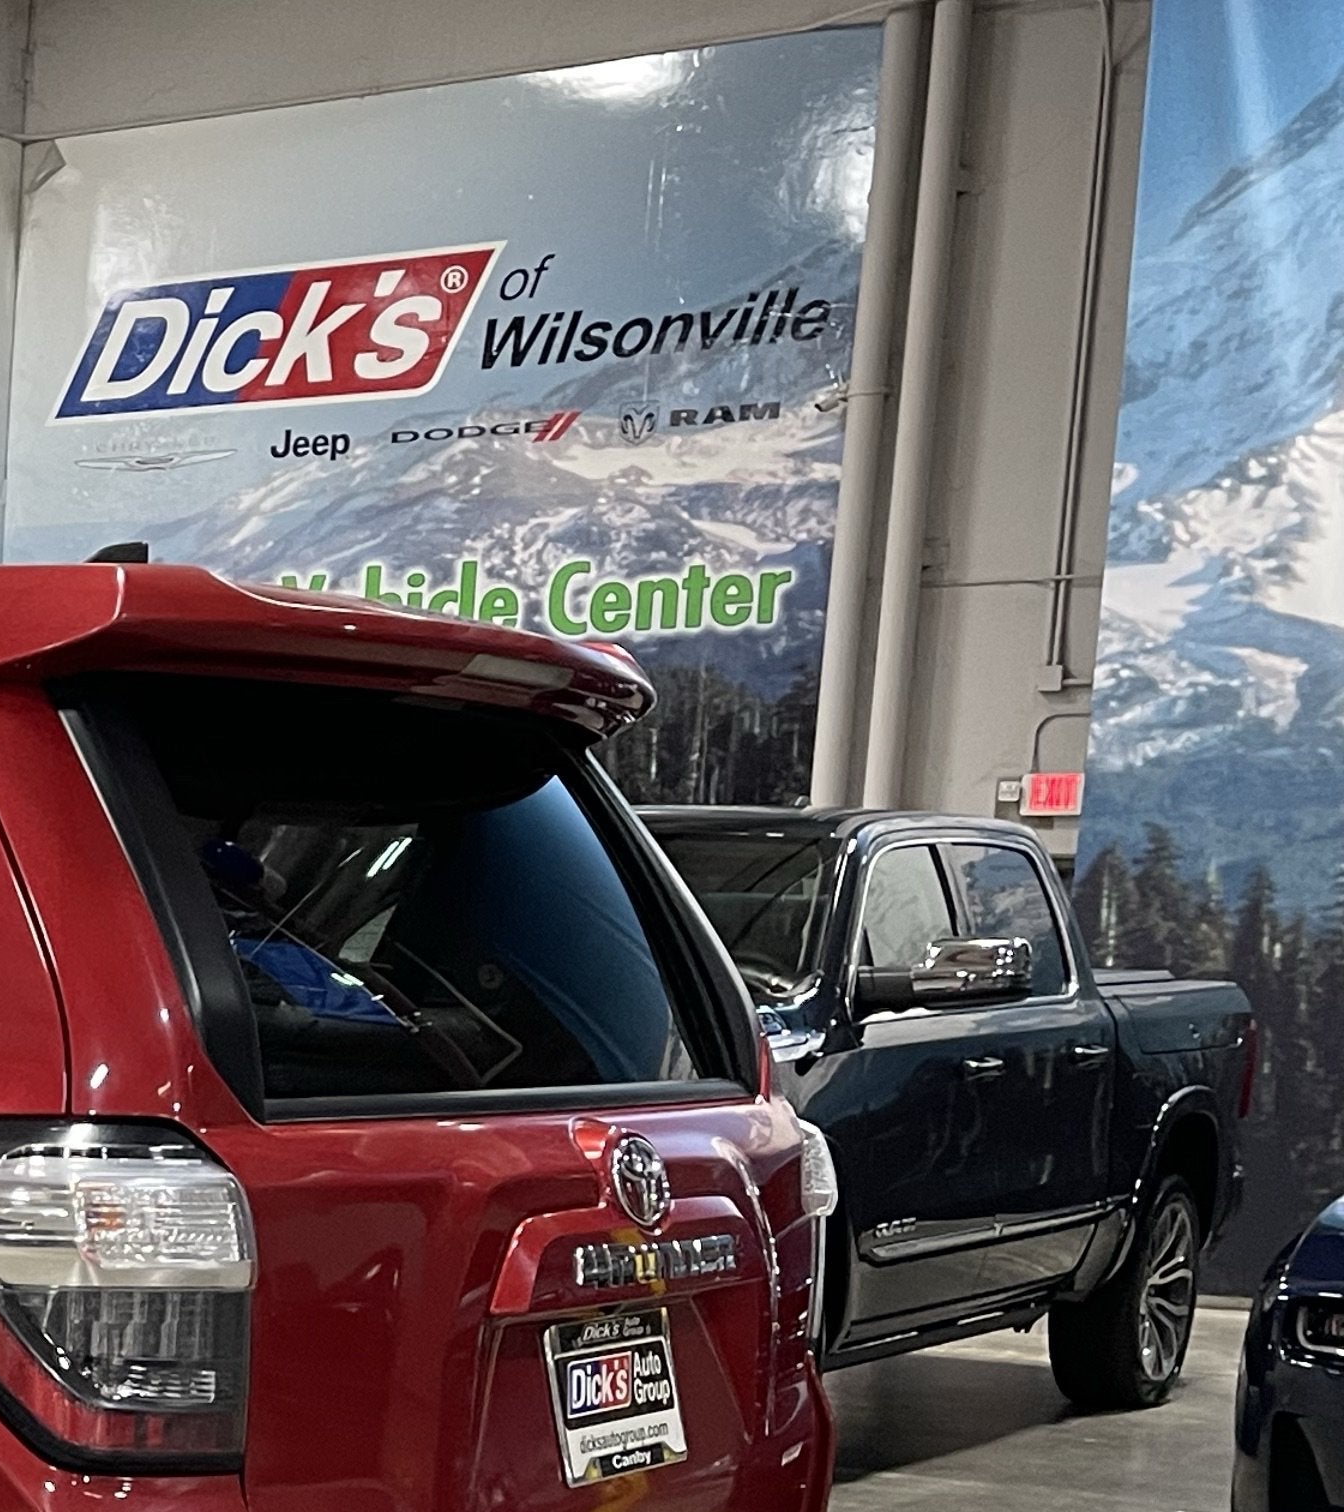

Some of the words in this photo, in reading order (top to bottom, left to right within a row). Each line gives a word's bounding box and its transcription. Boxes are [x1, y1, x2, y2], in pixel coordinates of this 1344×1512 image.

[499, 254, 556, 301] of
[80, 269, 445, 401] Dick's
[480, 288, 831, 370] Wilsonville
[391, 419, 551, 444] DODGE
[668, 402, 782, 428] RAM
[270, 430, 351, 461] Jeep
[281, 561, 519, 629] hicle
[548, 561, 793, 635] Center
[1031, 774, 1080, 809] EXIT
[634, 1351, 662, 1378] Auto
[572, 1360, 628, 1410] Dick's
[634, 1378, 671, 1406] Group
[579, 1422, 669, 1455] dicksautogroup.com
[612, 1449, 652, 1469] Canby
